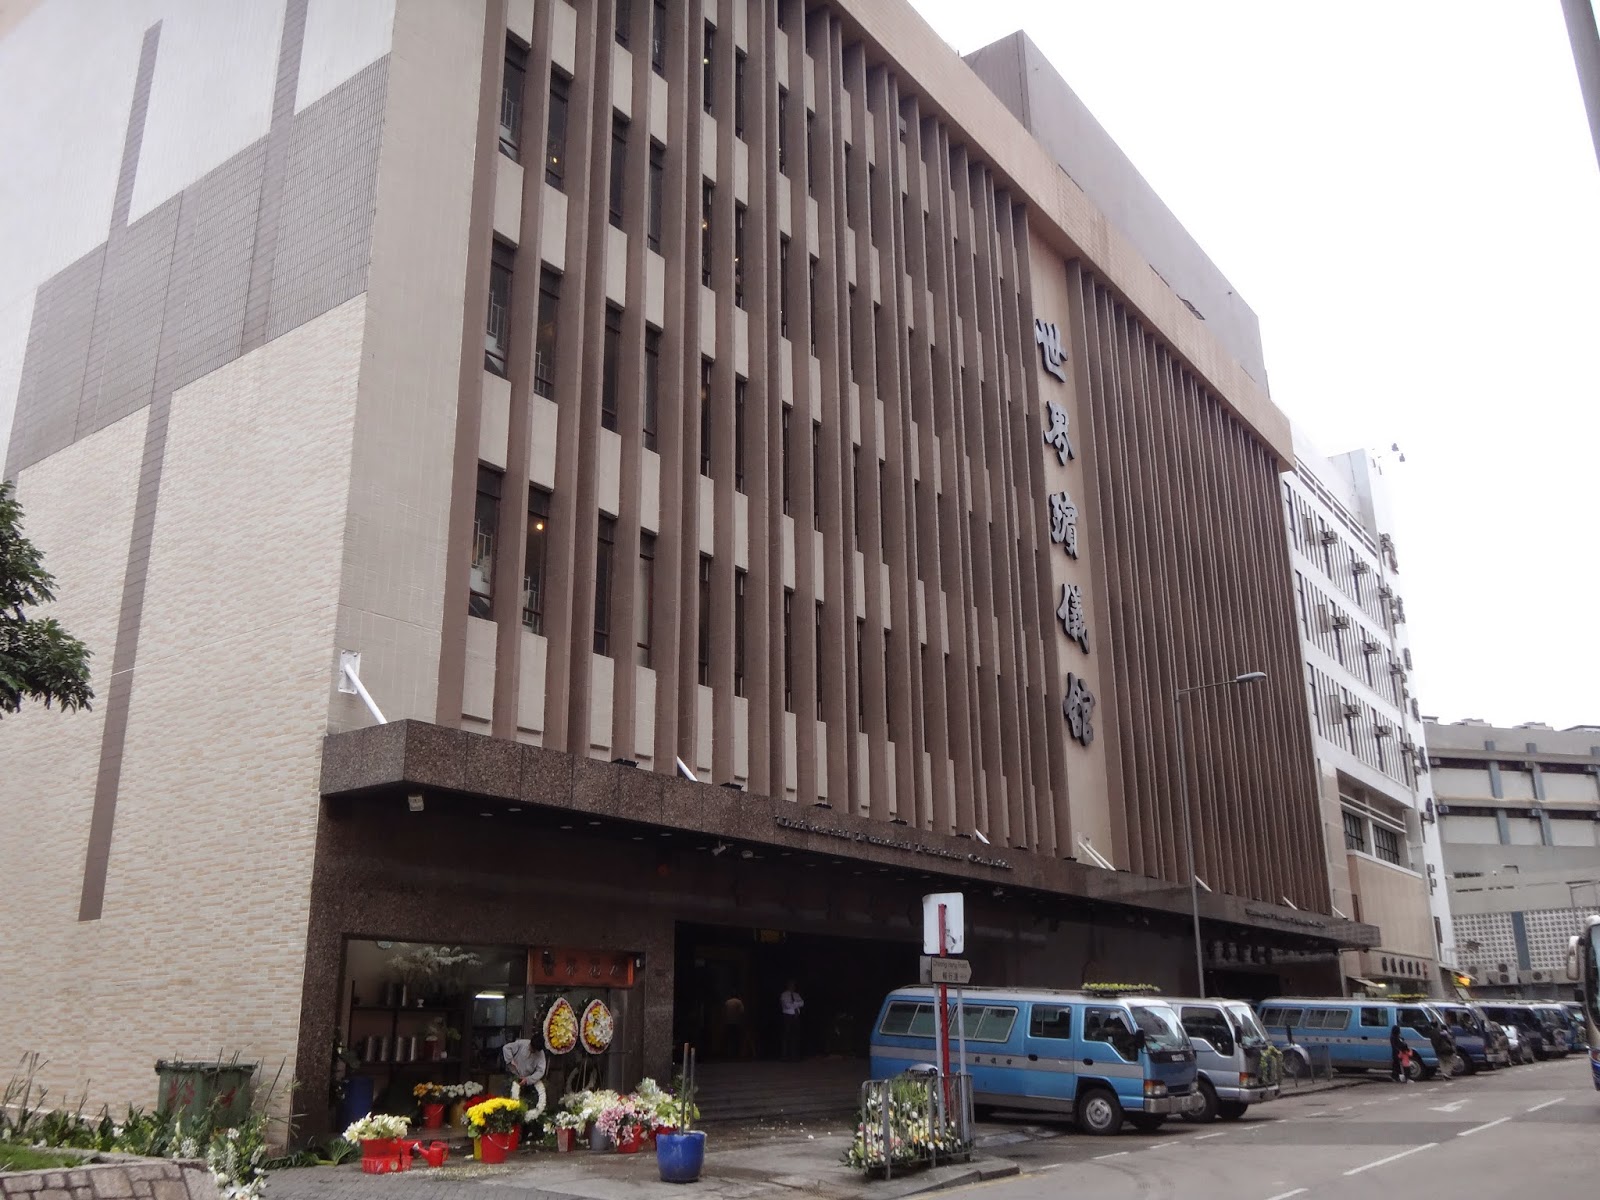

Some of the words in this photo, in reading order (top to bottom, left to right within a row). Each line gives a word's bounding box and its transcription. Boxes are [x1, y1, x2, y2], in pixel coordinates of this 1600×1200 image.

[1034, 318, 1097, 747] 世界殯儀館
